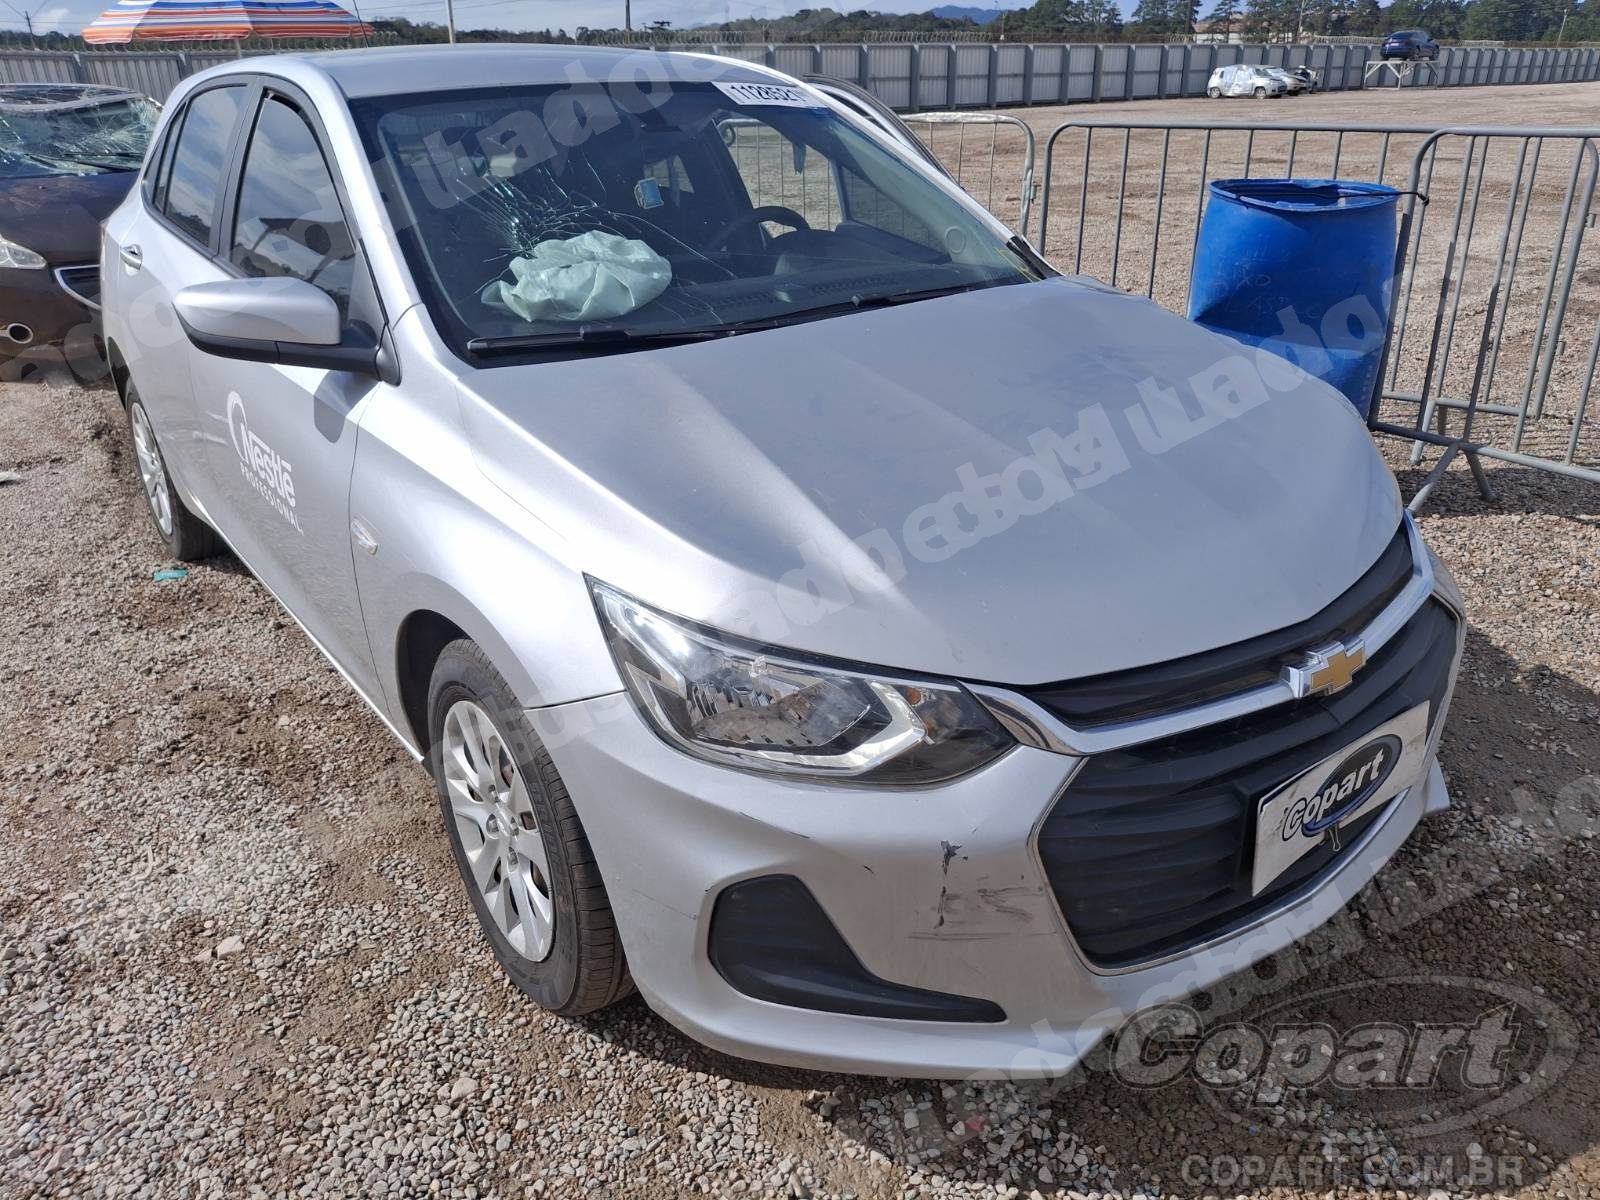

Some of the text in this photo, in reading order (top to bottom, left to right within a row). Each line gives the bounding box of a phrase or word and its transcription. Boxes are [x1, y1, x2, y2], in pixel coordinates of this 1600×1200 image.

[730, 84, 806, 103] 1128521
[235, 414, 296, 507] Nestlé
[1282, 748, 1385, 841] Copart
